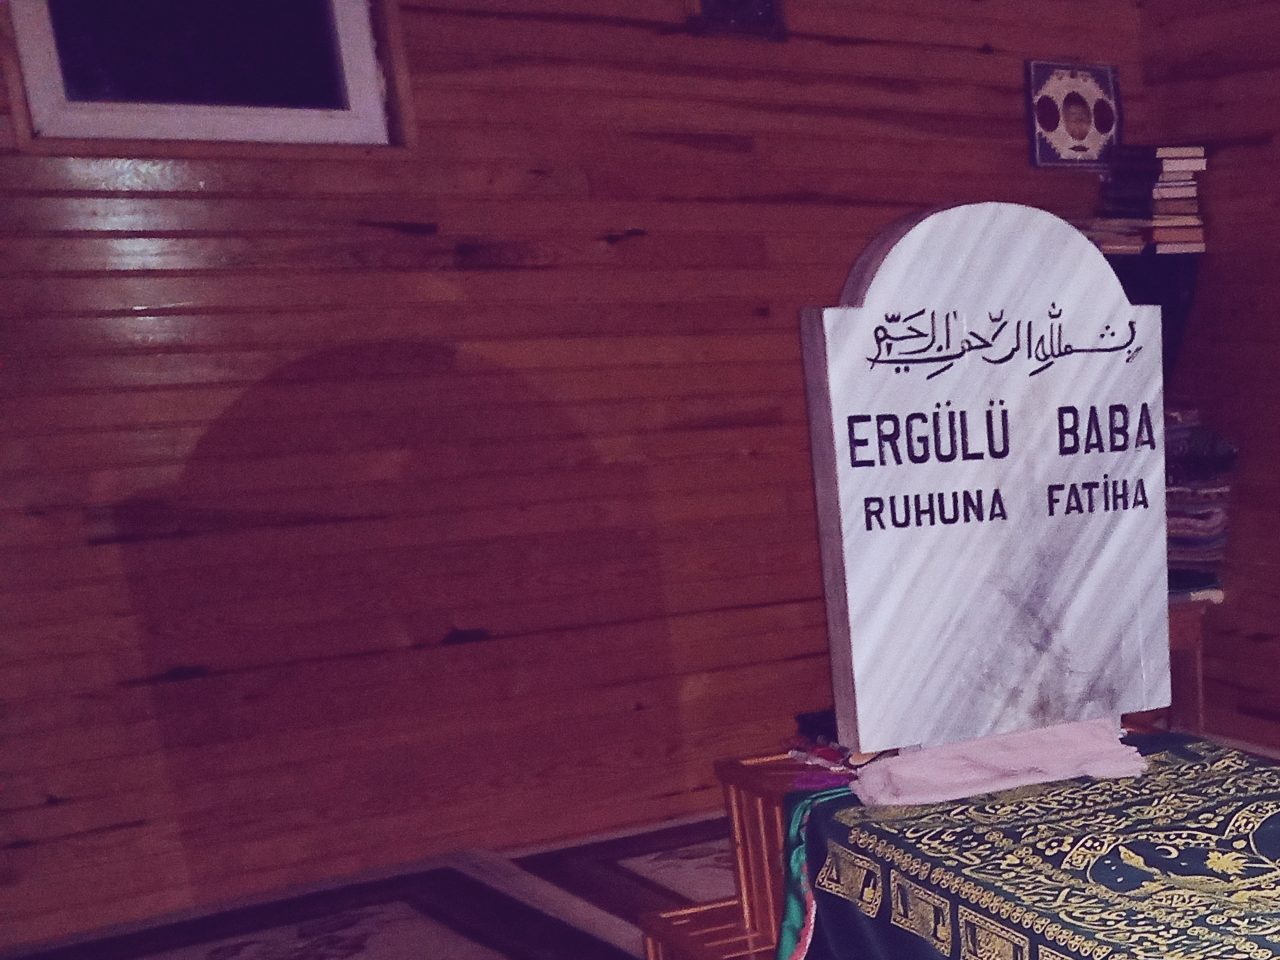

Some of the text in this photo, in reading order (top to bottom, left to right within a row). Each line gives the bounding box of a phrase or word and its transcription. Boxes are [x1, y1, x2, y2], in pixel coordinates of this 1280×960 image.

[847, 400, 1156, 468] ERGÜLÜ BABA
[864, 473, 1149, 531] RUHUNA FATİHA
